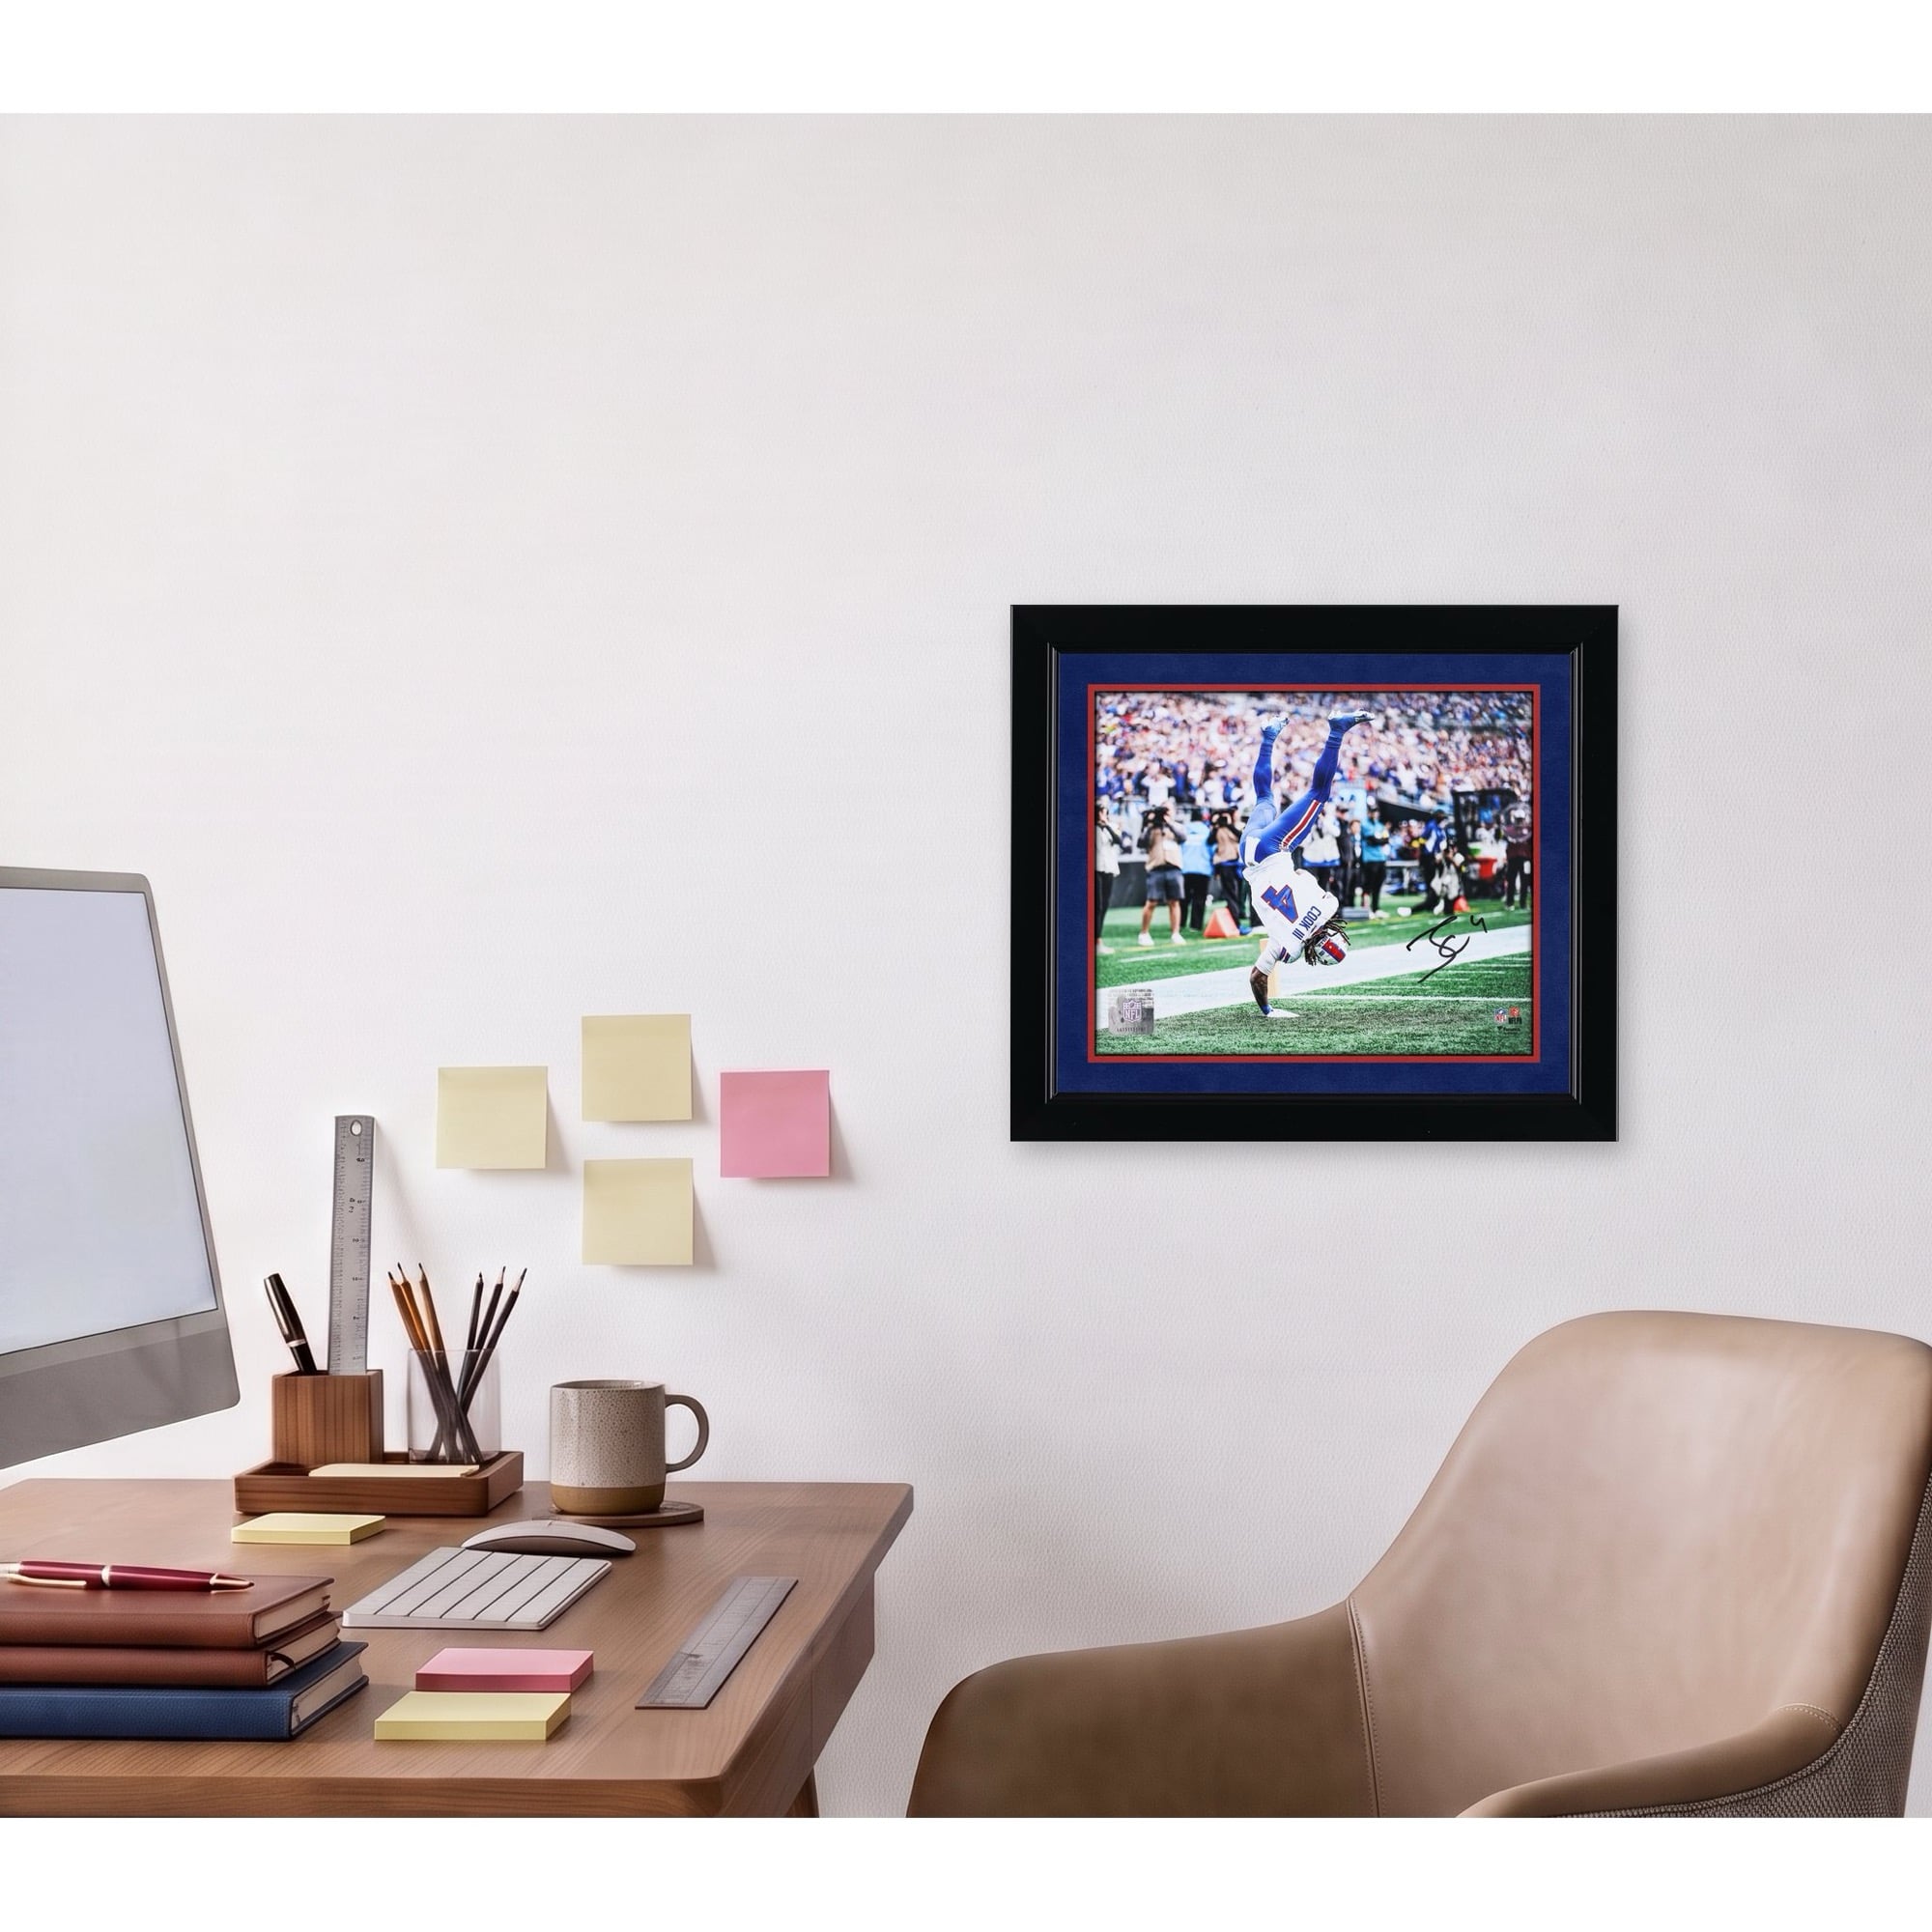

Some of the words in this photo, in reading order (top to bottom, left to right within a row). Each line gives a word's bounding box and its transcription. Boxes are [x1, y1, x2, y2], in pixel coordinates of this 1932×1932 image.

[1261, 884, 1298, 923] 4
[1298, 905, 1321, 931] COOK
[1292, 927, 1305, 941] III
[1124, 1009, 1139, 1020] NFL
